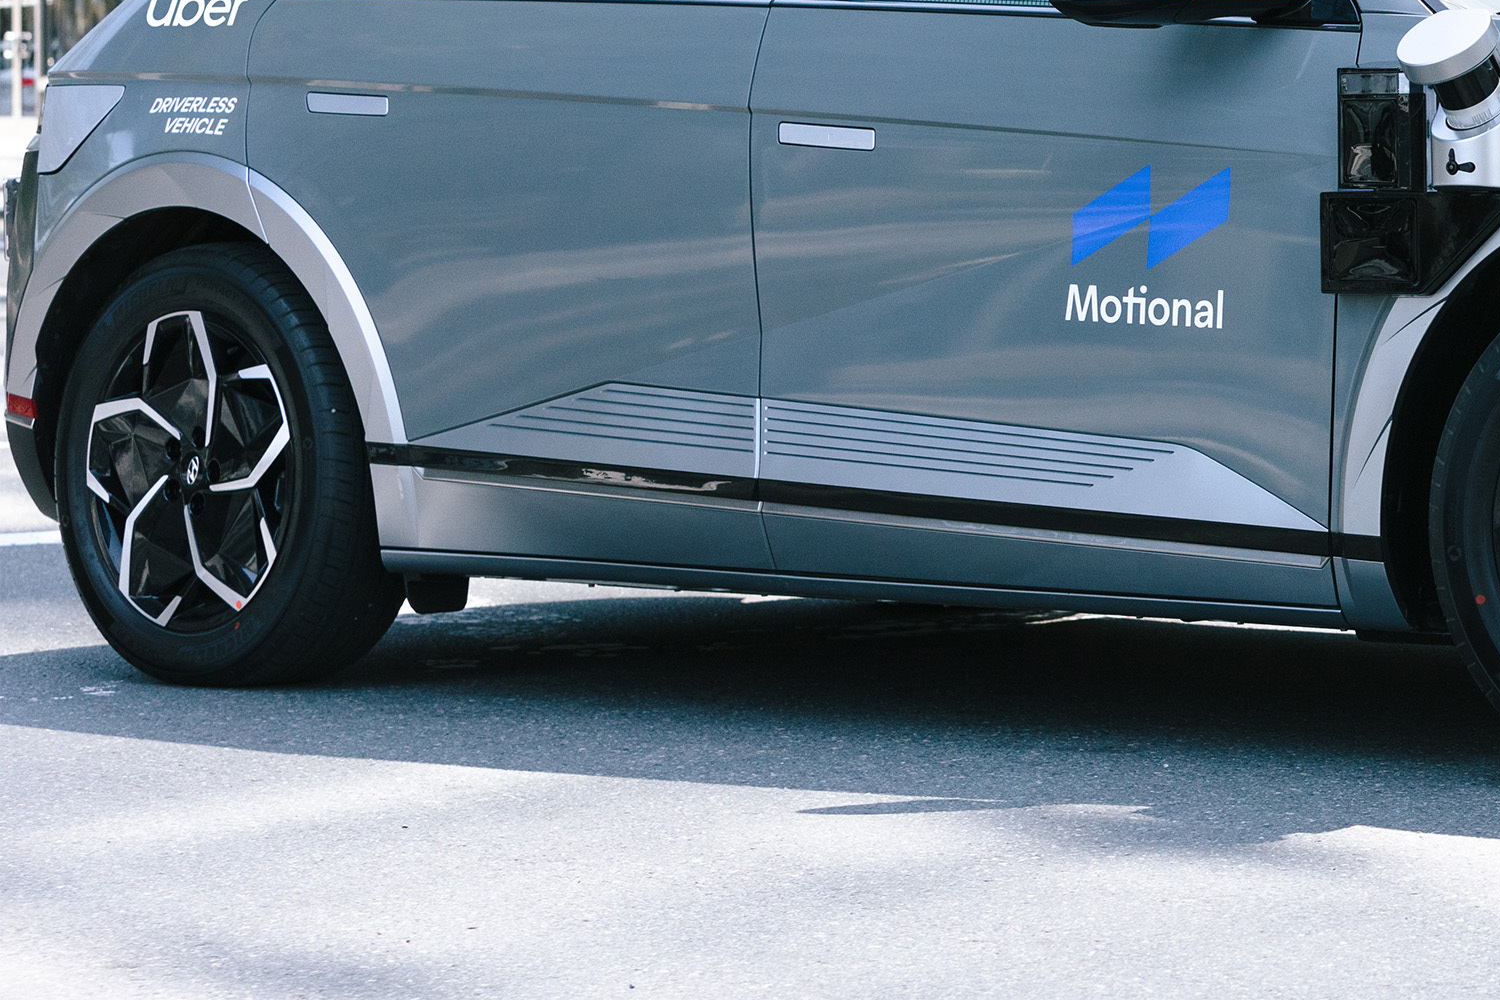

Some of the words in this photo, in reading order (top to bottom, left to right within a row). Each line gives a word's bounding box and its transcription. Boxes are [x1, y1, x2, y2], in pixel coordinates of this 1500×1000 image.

[149, 97, 238, 114] DRIVERLESS
[163, 117, 229, 136] VEHICLE
[1064, 283, 1225, 329] Motional
